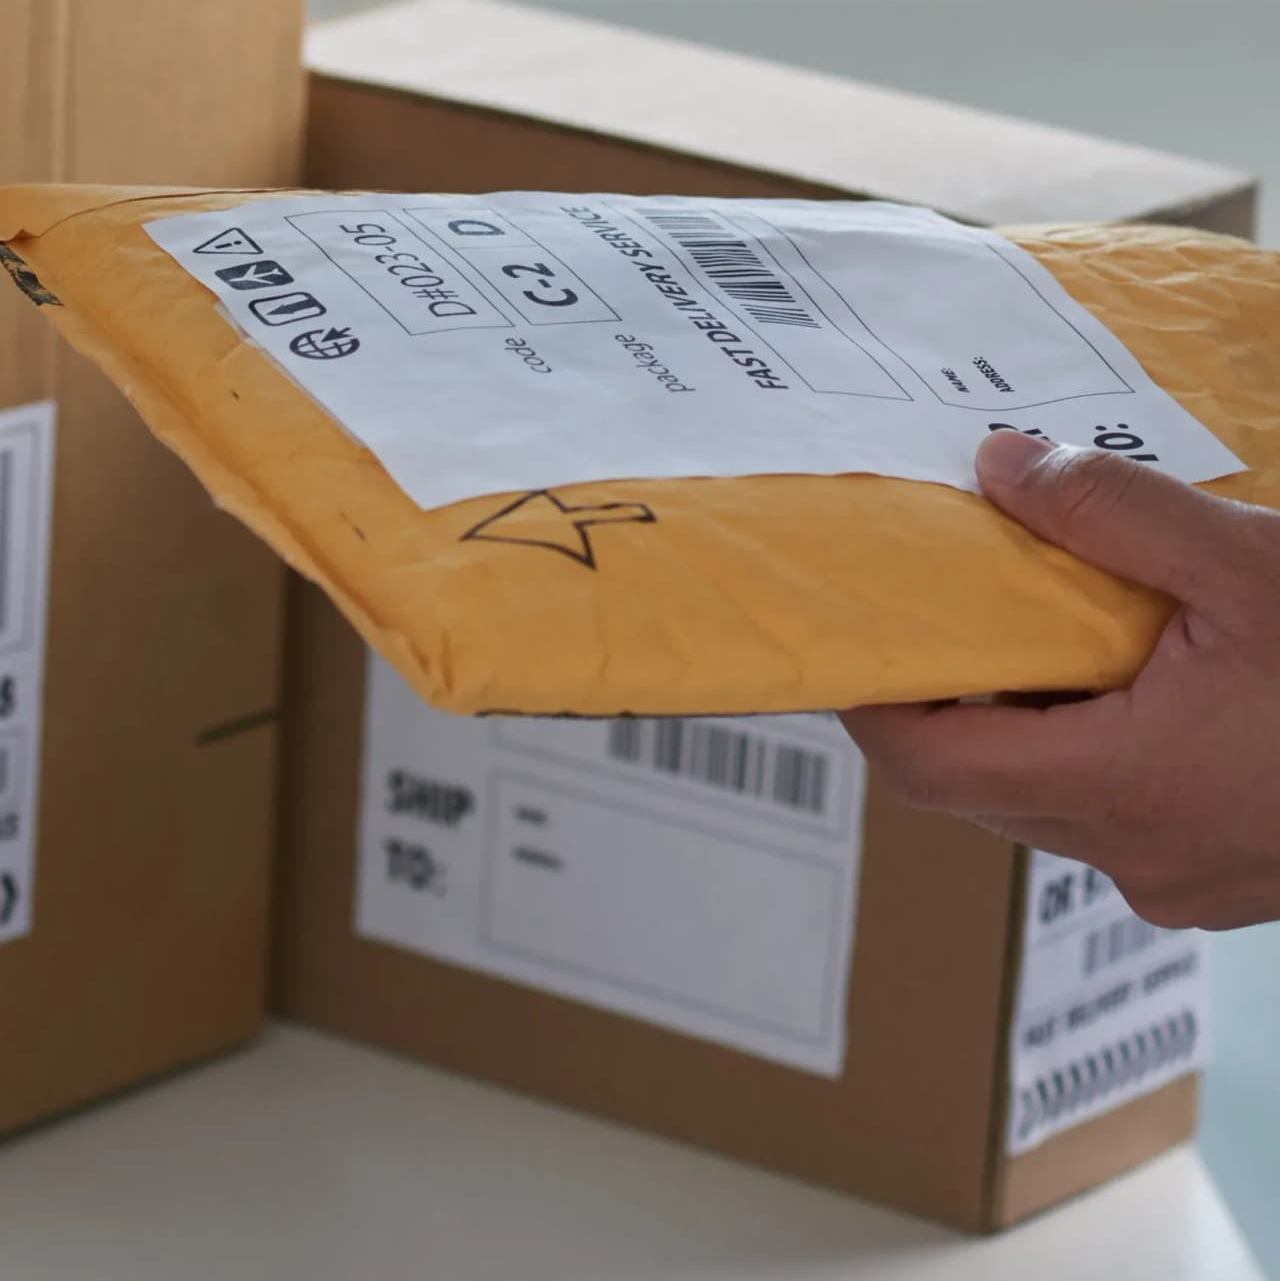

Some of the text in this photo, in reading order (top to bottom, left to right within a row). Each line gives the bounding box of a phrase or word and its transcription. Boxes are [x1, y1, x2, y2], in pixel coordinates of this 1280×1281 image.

[338, 223, 478, 318] D#023-05
[447, 219, 579, 307] C-2 D
[558, 206, 790, 390] FAST DELIVERY SERVICE
[505, 336, 553, 375] code
[613, 332, 698, 394] package
[972, 356, 1016, 393] ADDRESS:
